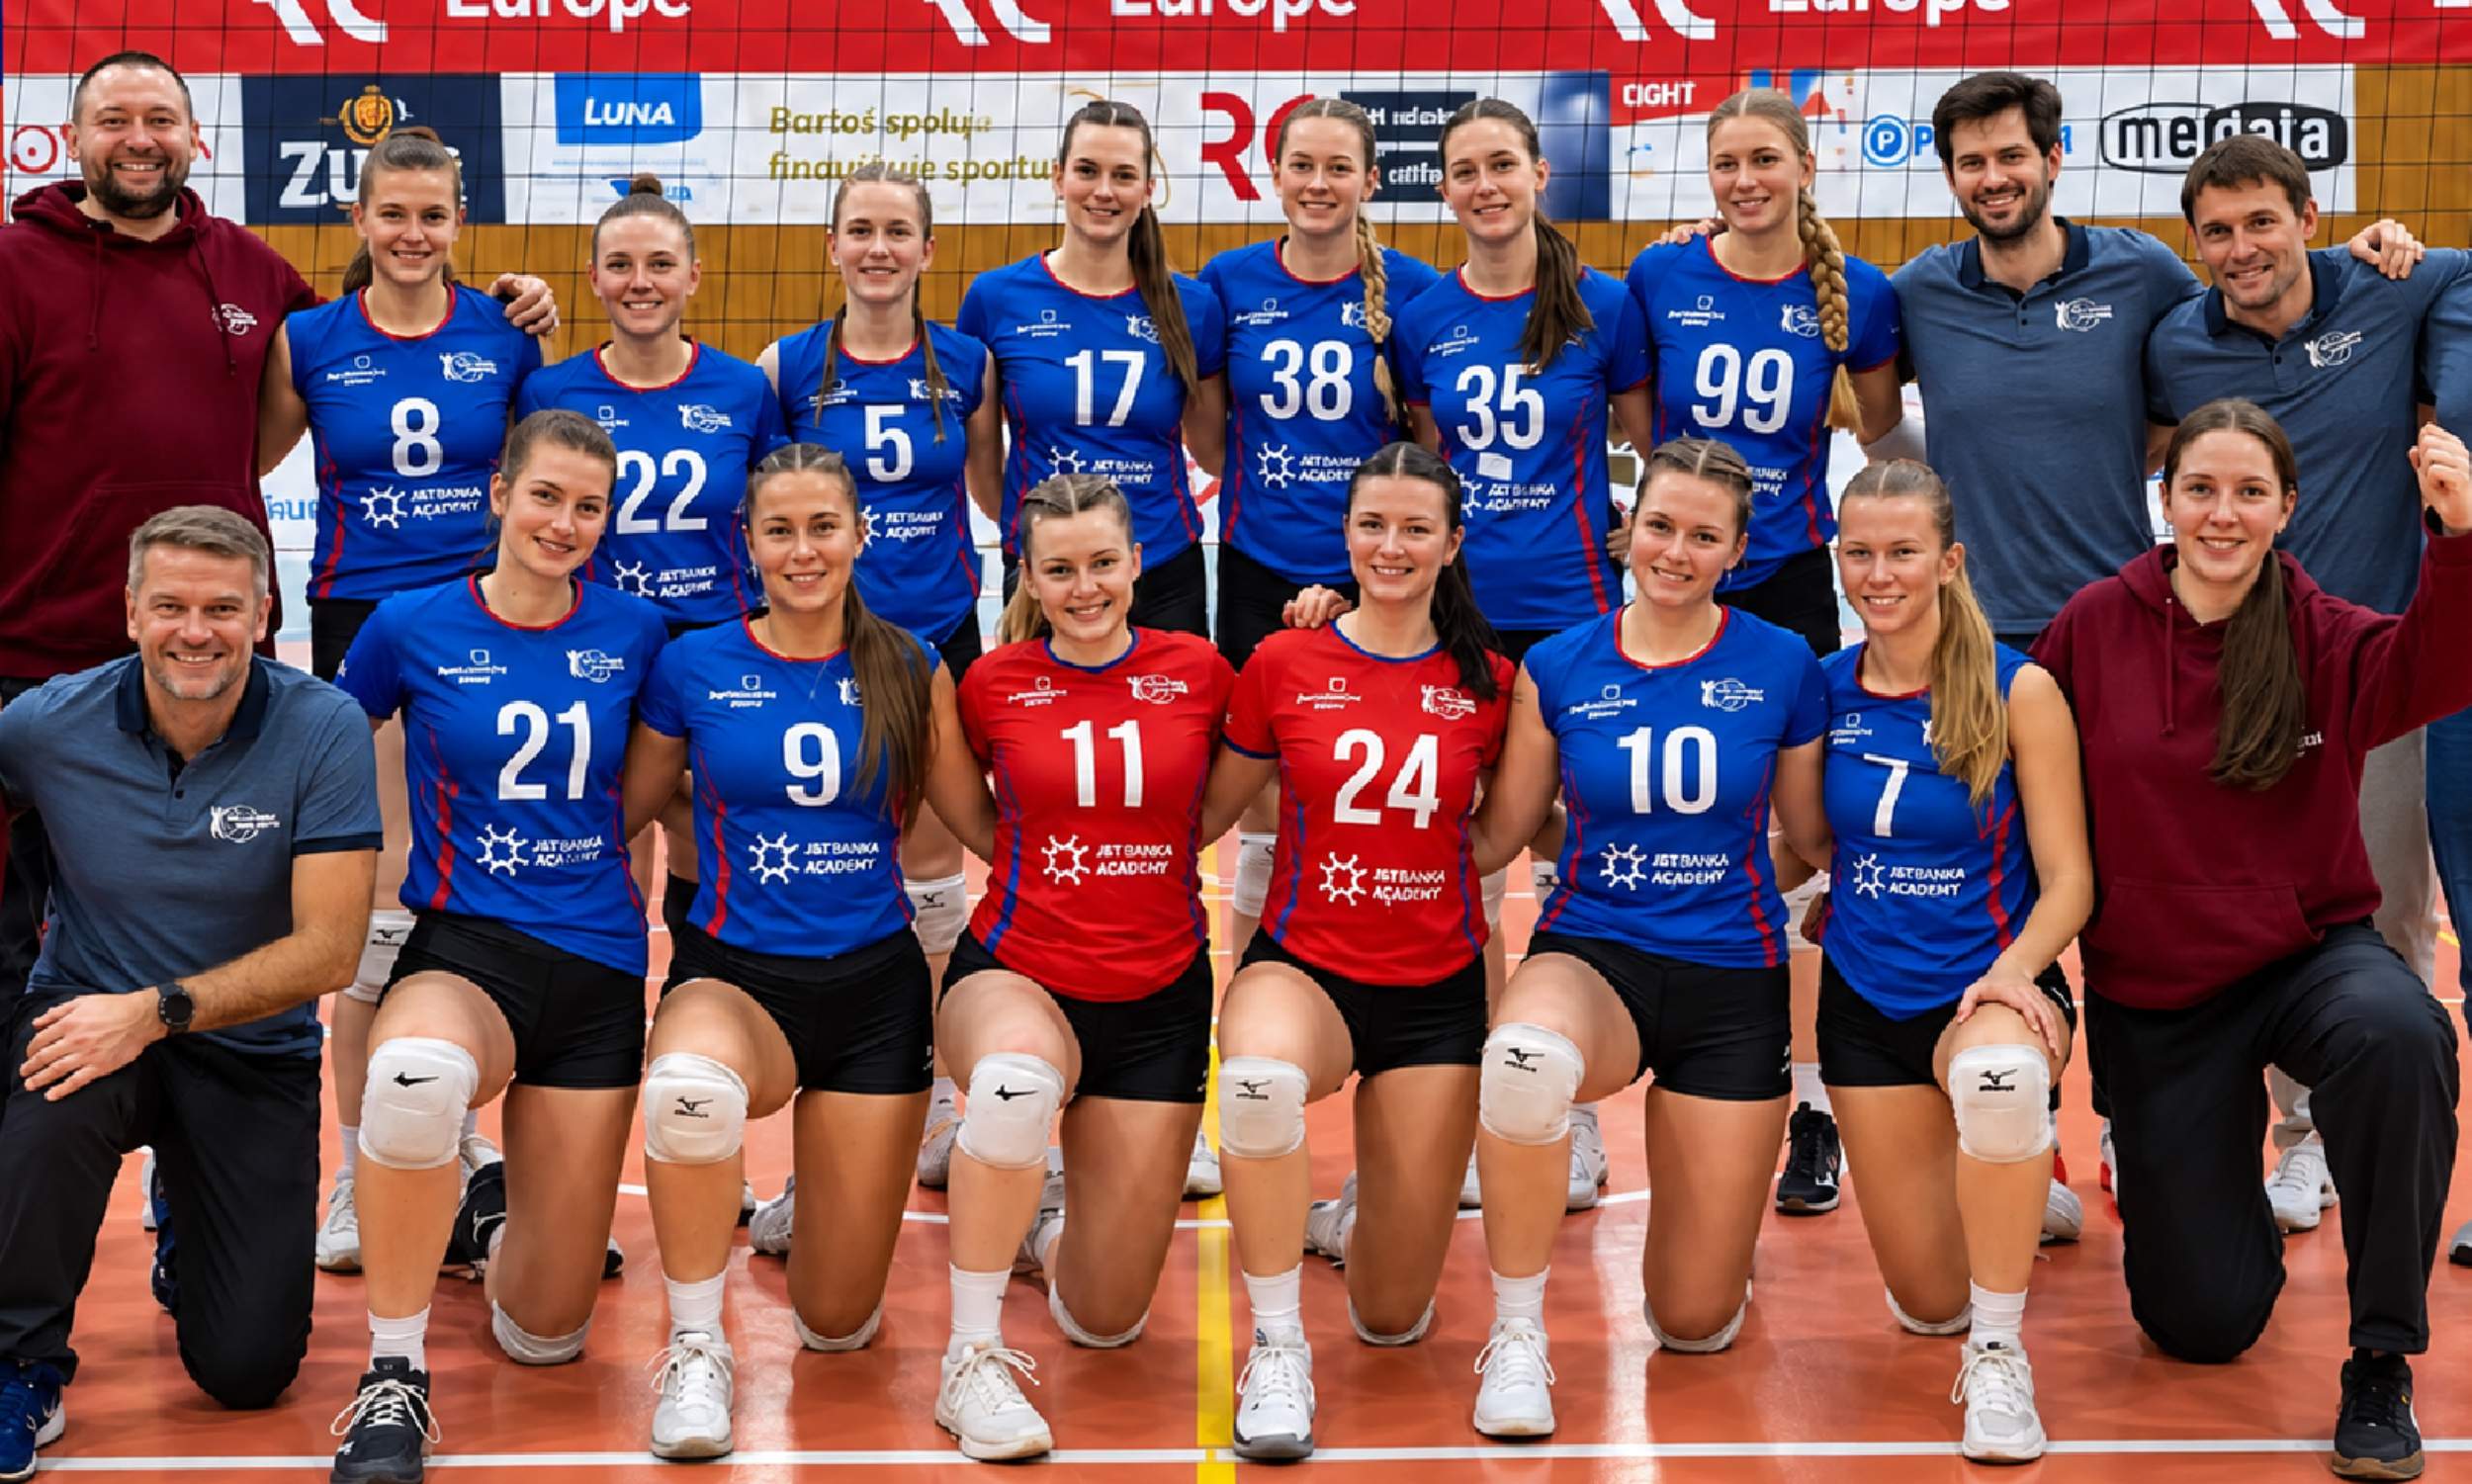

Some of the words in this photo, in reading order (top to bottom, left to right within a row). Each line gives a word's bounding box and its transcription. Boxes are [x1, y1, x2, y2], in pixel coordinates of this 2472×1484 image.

[584, 97, 674, 126] LUNA
[769, 106, 875, 134] Bartoš
[1065, 349, 1145, 427] 17
[1260, 339, 1353, 421] 38
[1456, 364, 1545, 451] 35
[1693, 343, 1795, 434] 99
[391, 397, 443, 478] 8
[863, 404, 915, 482] 5
[615, 450, 708, 535] 22
[496, 700, 591, 800] 21
[783, 722, 840, 806] 9
[1060, 720, 1143, 807] 11
[1334, 728, 1441, 829] 24
[1617, 726, 1717, 815] 10
[1864, 752, 1908, 837] 7
